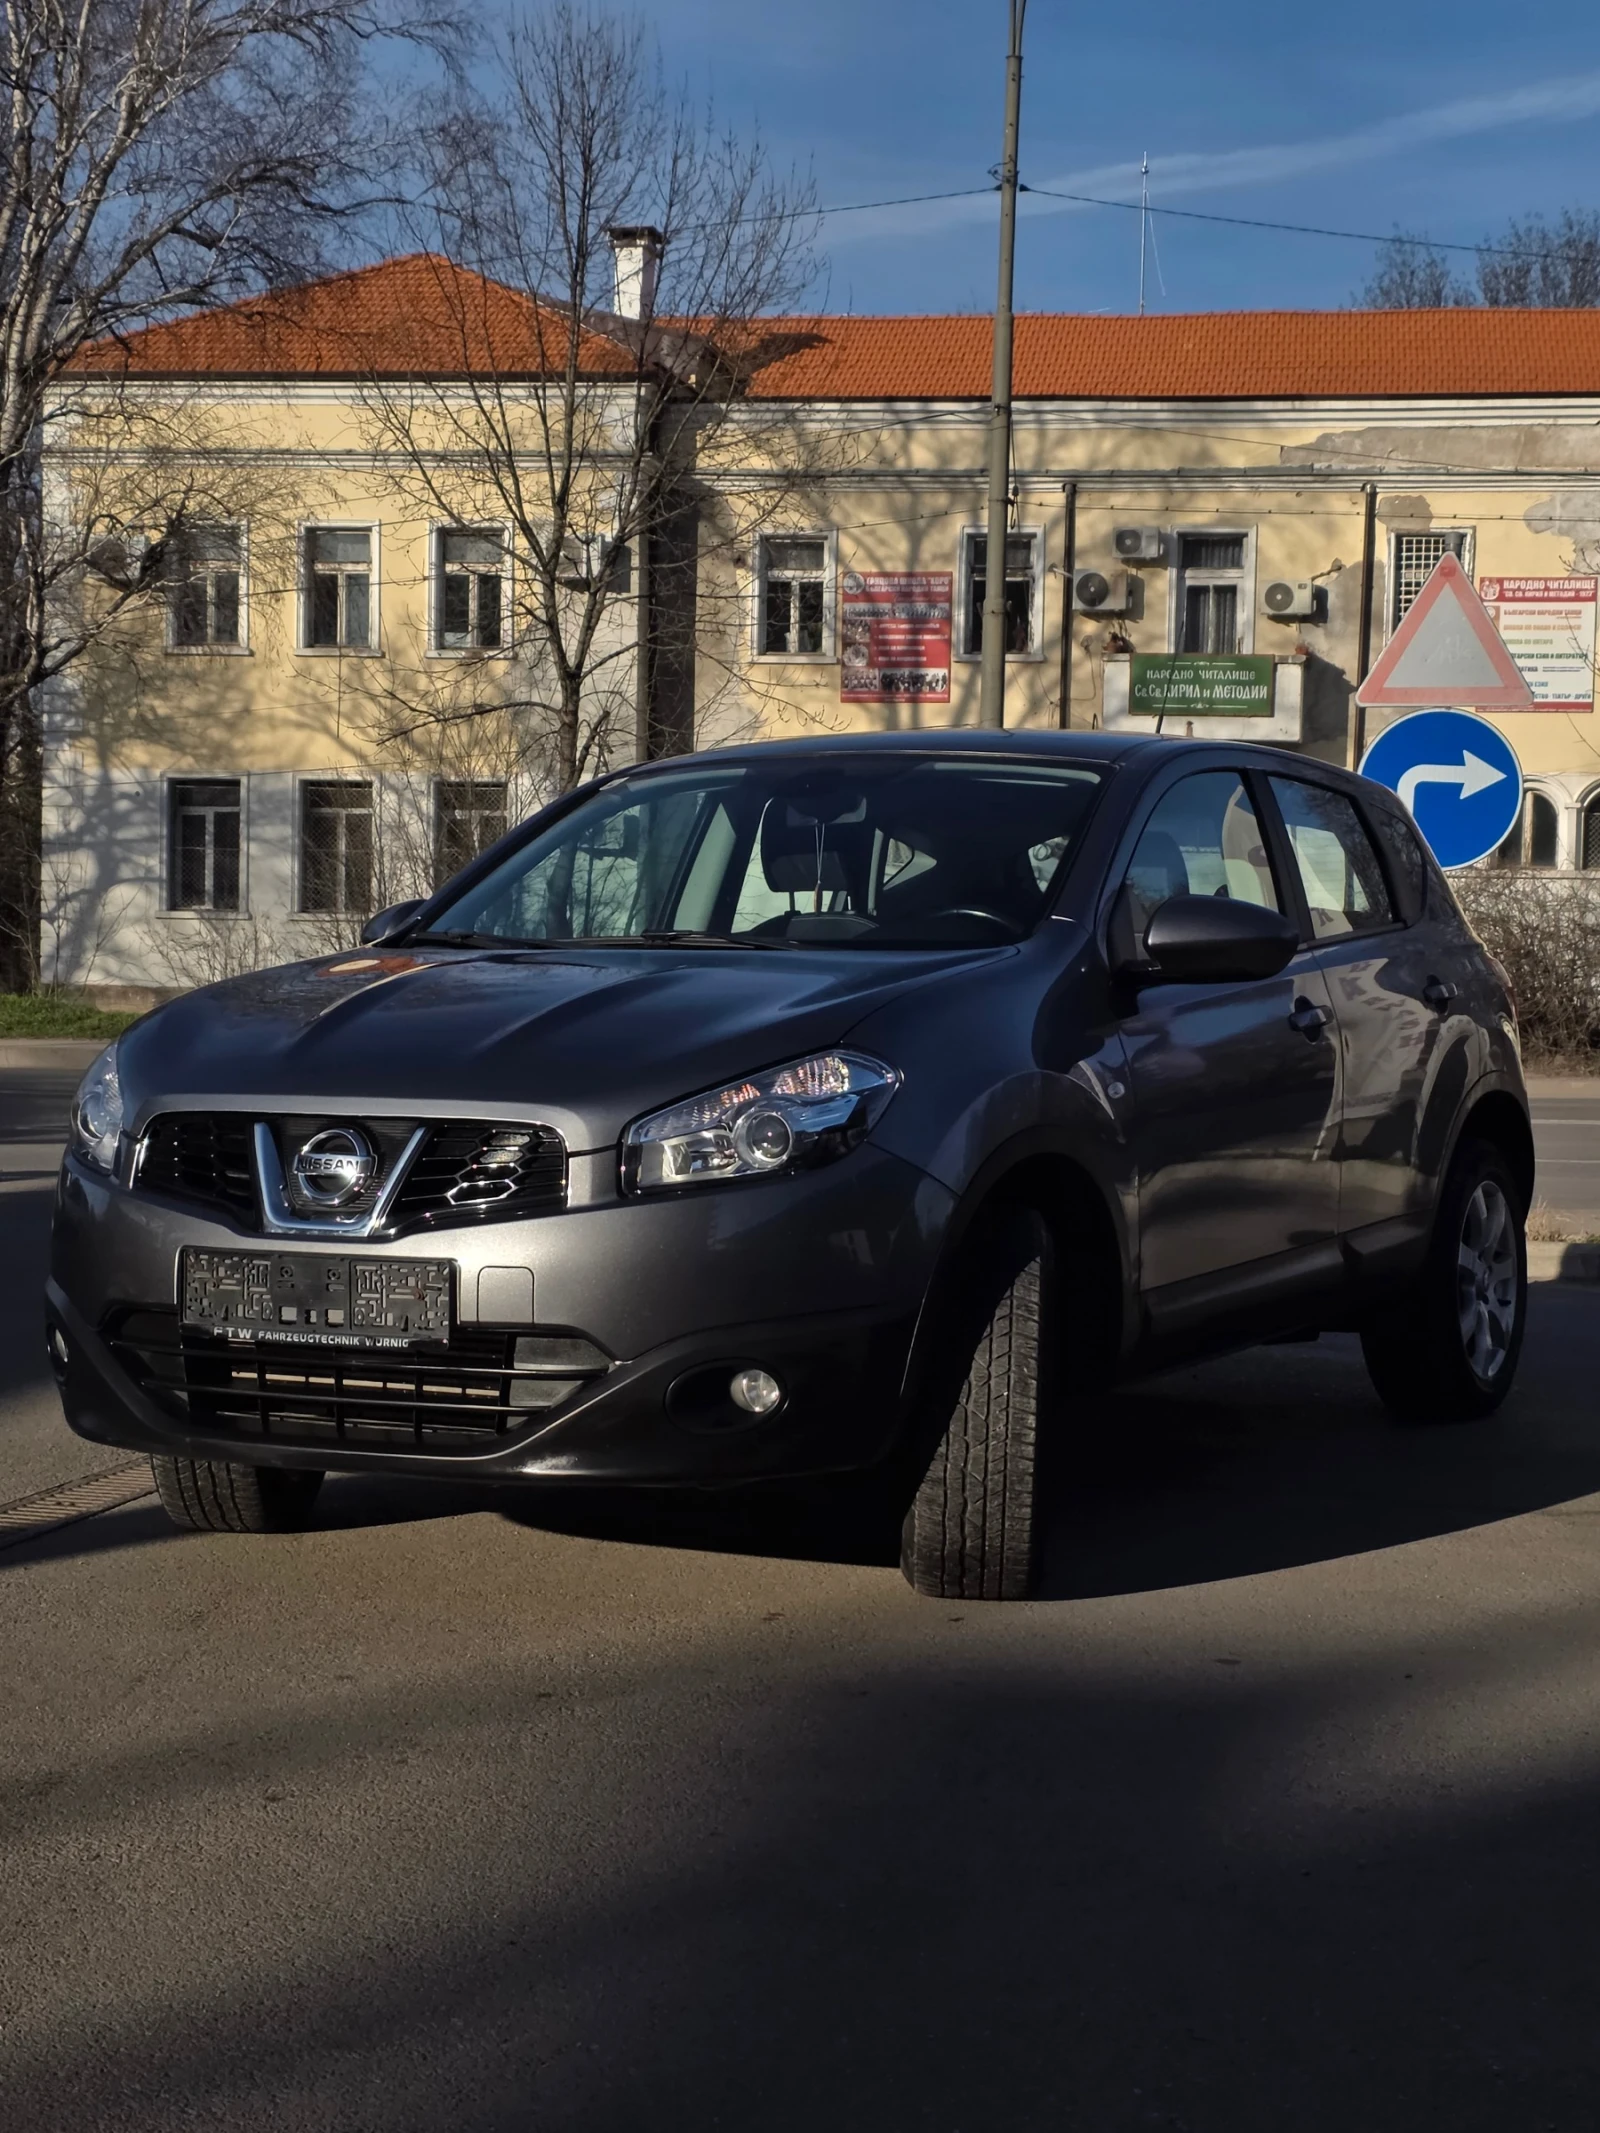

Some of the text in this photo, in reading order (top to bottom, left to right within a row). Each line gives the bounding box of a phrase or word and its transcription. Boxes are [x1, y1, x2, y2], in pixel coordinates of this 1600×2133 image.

[1503, 579, 1596, 590] НАРОДНО ЧИТАЛИЩЕ
[1525, 590, 1543, 598] КИРИЛ
[1548, 590, 1575, 598] МЕТОДИЙ
[1146, 669, 1256, 680] НАРОДНО ЧИТАЛИЩЕ
[1163, 684, 1201, 698] КИРИЛ
[1212, 683, 1268, 699] МЕТОДИЙ
[299, 1157, 360, 1171] NISSAN
[213, 1326, 253, 1339] FTW
[258, 1330, 360, 1346] FAHRZEUGTECHNIK
